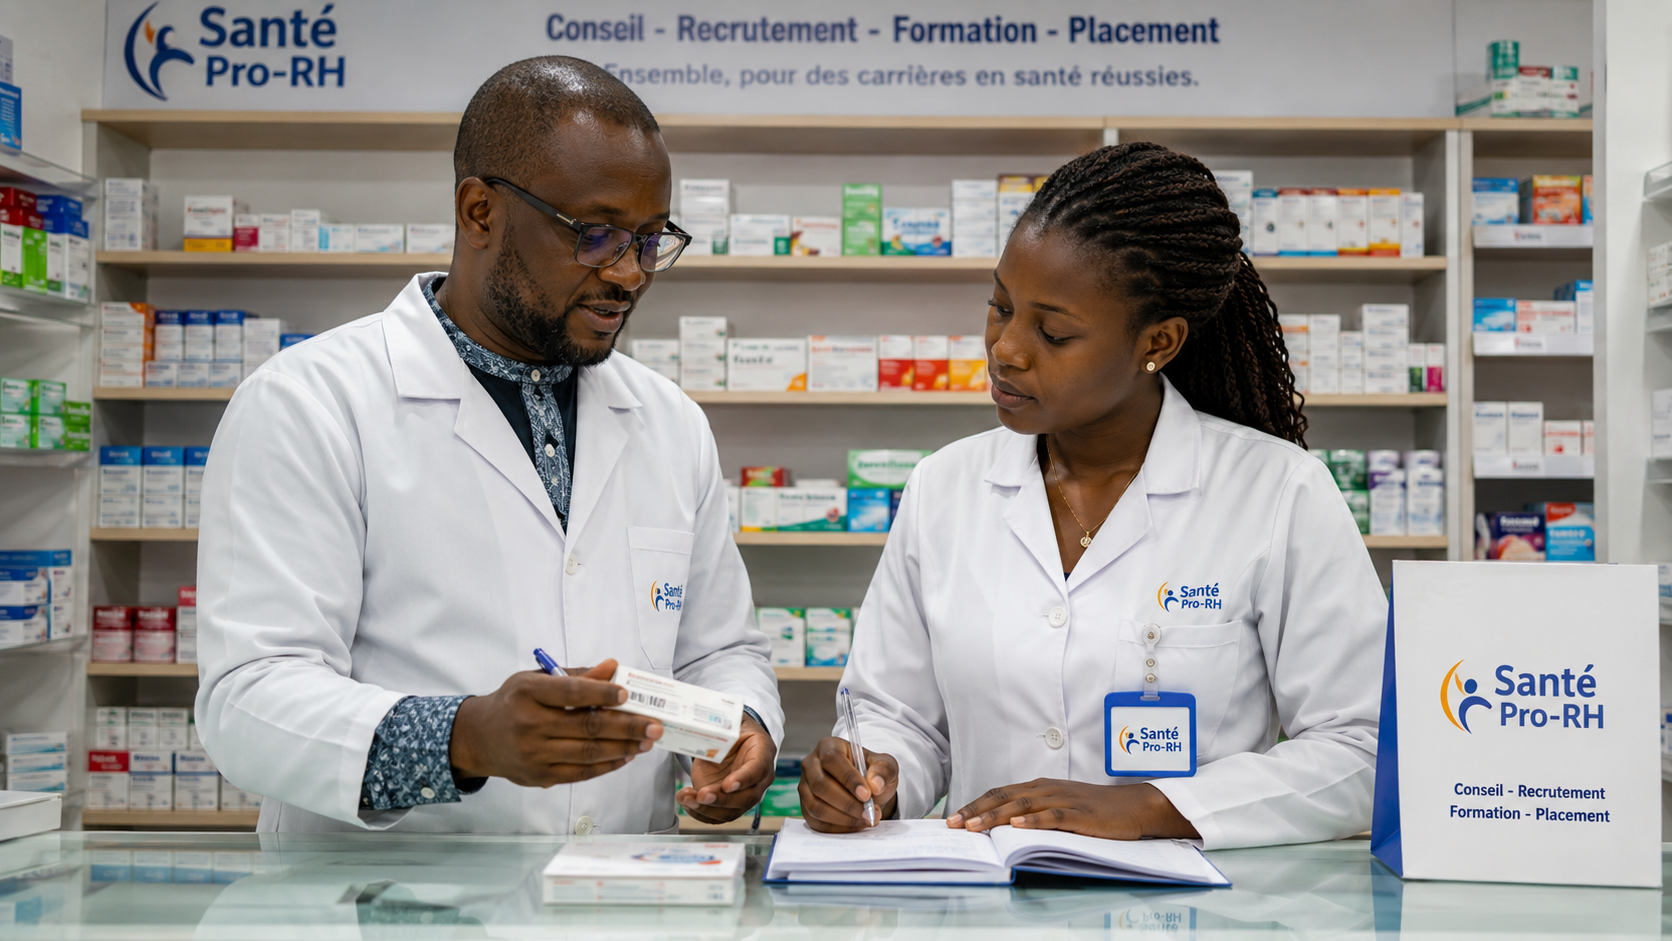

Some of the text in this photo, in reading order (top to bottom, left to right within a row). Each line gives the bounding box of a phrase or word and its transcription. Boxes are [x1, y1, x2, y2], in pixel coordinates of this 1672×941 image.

[199, 3, 337, 49] Santé
[545, 13, 644, 42] Conseil
[677, 14, 858, 43] Recrutement
[893, 15, 1037, 44] Formation
[1069, 16, 1220, 44] Placement
[205, 55, 346, 88] Pro-RH
[739, 68, 798, 90] pour
[805, 64, 850, 86] des
[857, 64, 968, 87] carrières
[975, 69, 1006, 87] en
[1014, 65, 1083, 87] santé
[1090, 65, 1200, 87] réussies.
[1179, 582, 1220, 598] Santé
[1181, 598, 1222, 610] Pro-RH
[1494, 663, 1597, 698] Santé
[1500, 702, 1604, 729] Pro-RH
[1140, 726, 1179, 740] Santé
[1142, 741, 1182, 752] Pro-RH
[1454, 782, 1504, 797] Conseil
[1518, 784, 1606, 800] Recrutement
[1450, 804, 1521, 820] Formation
[1535, 807, 1611, 823] Placement
